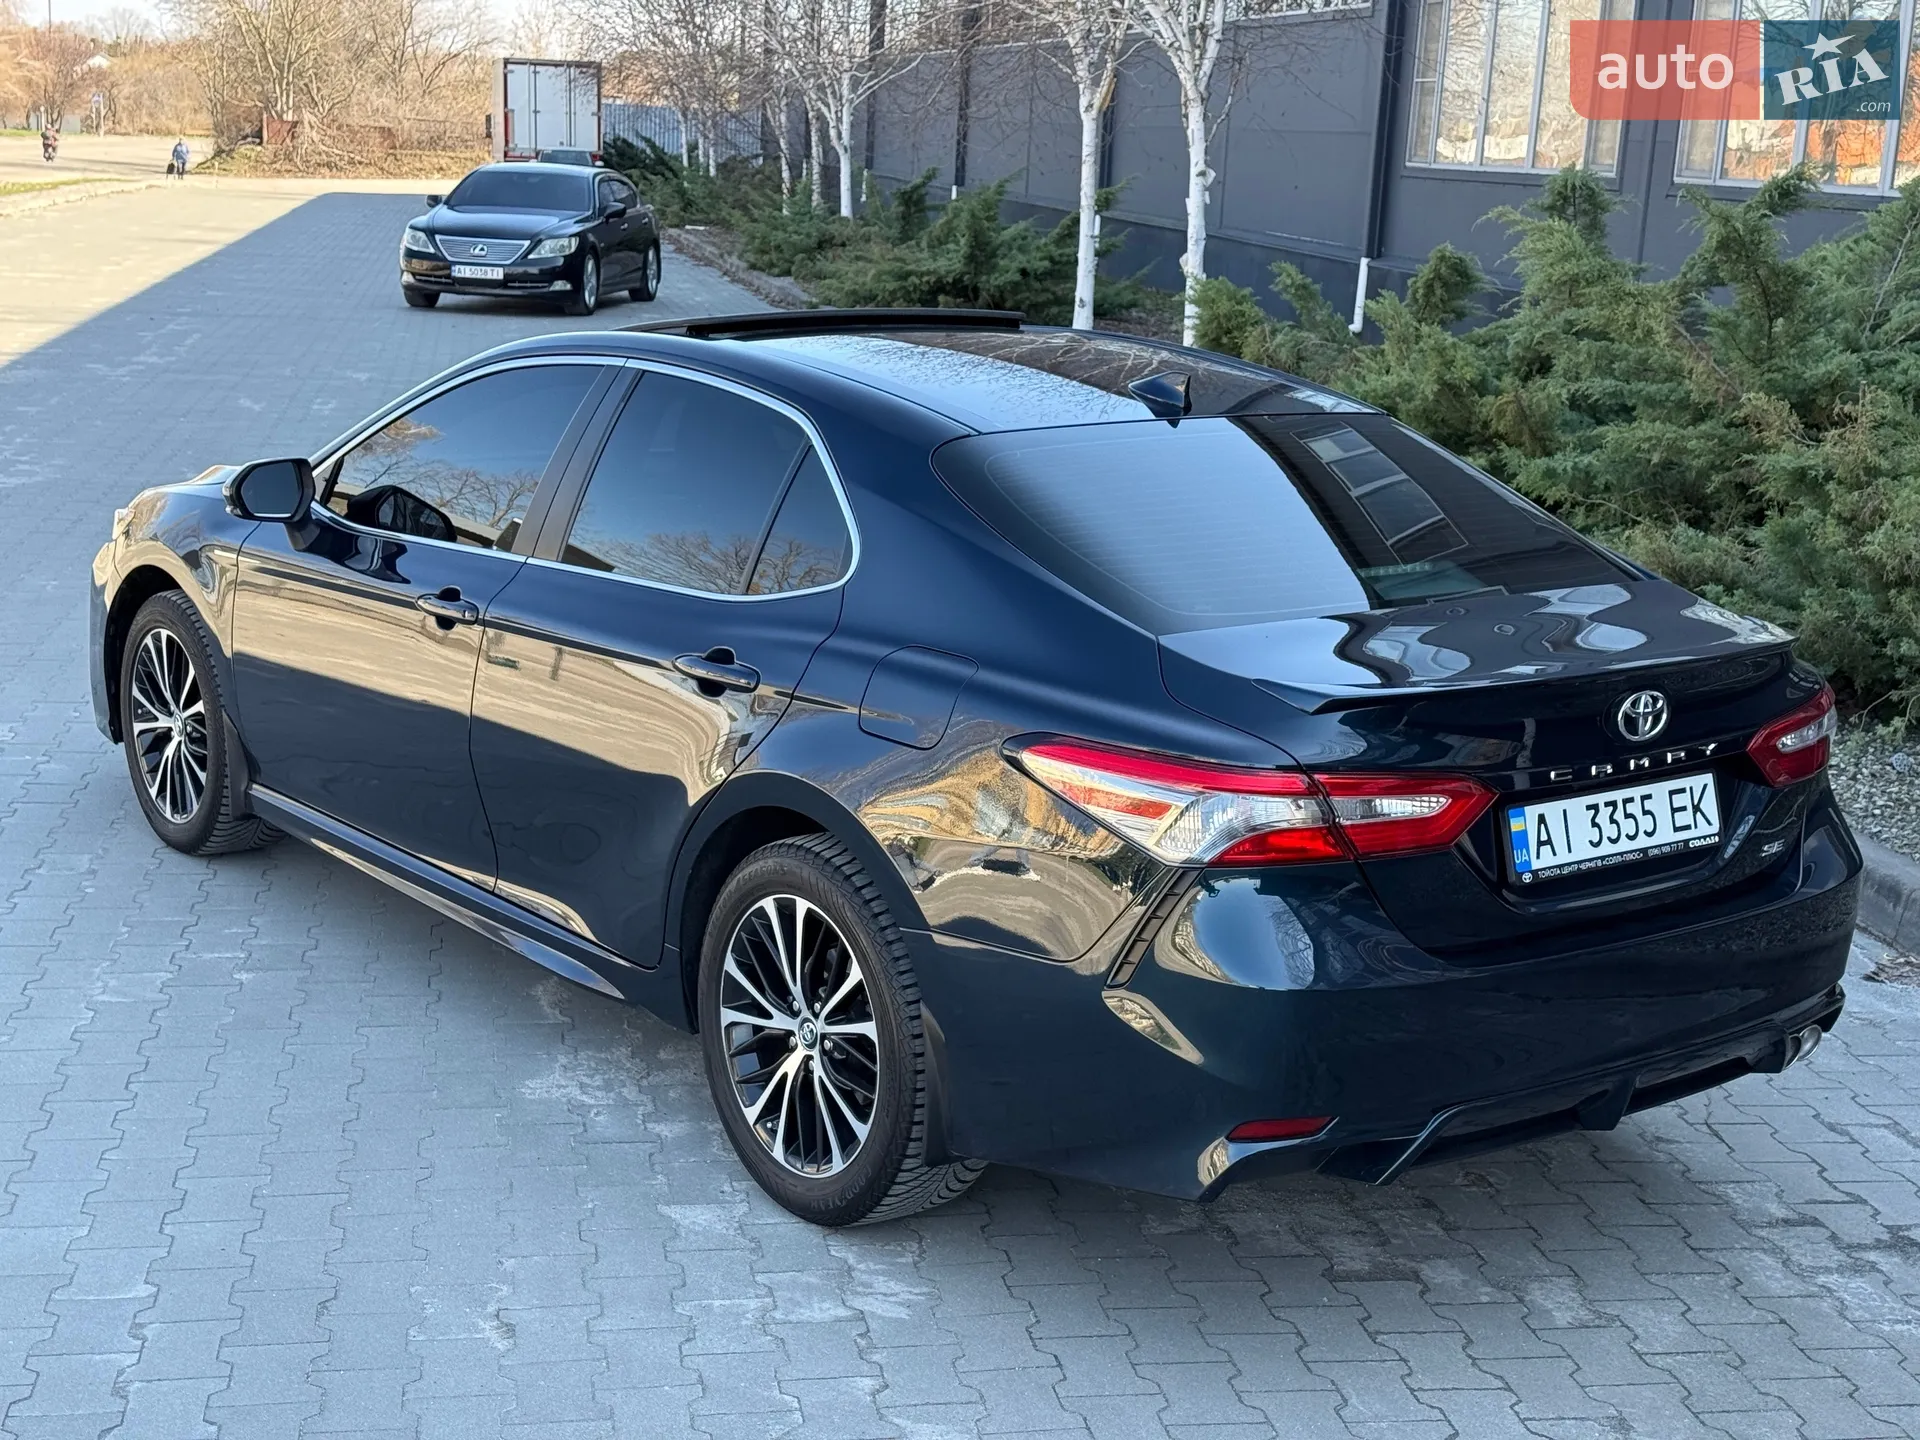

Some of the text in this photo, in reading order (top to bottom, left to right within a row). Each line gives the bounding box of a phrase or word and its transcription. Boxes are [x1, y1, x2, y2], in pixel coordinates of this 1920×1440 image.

[1550, 742, 1718, 782] CAMRY
[1535, 783, 1714, 861] AI 3355 EK
[1514, 848, 1530, 864] UA
[1760, 839, 1785, 857] SE
